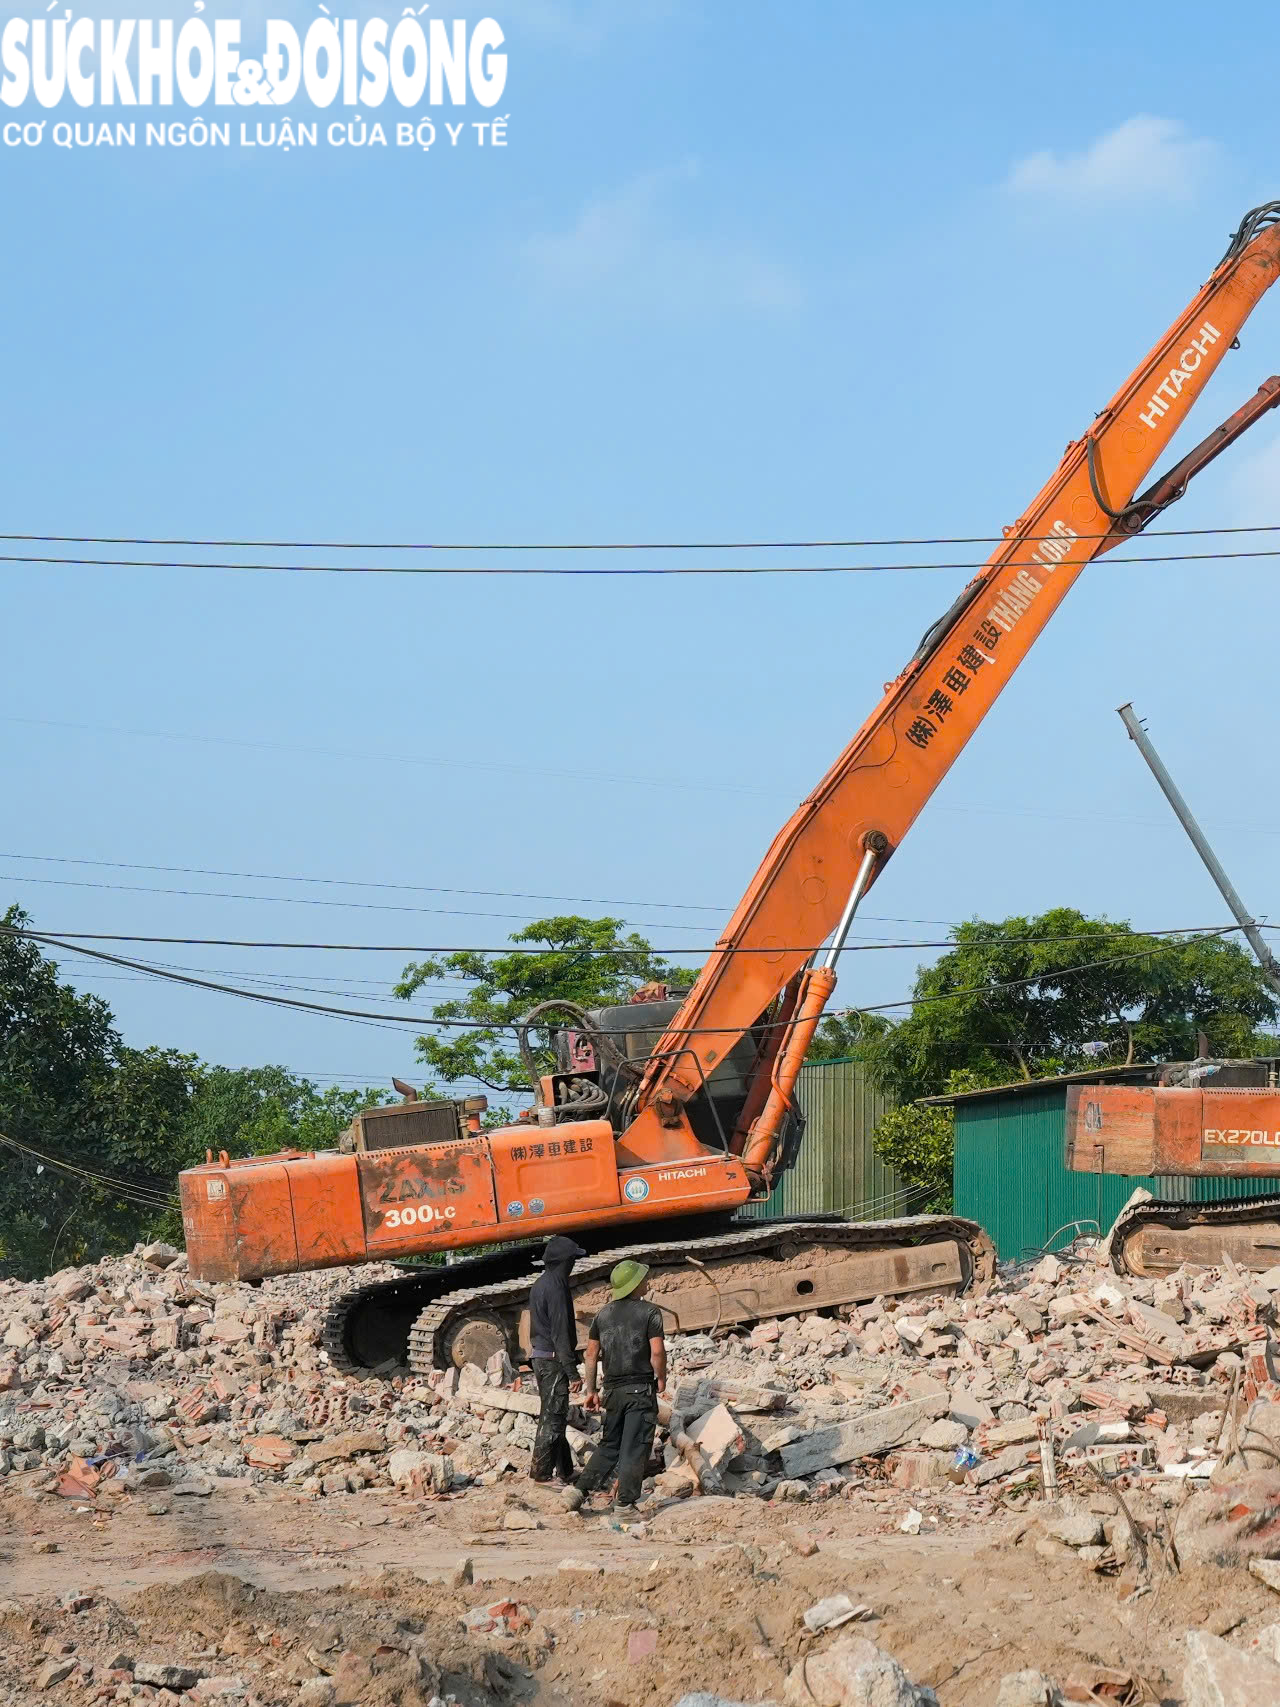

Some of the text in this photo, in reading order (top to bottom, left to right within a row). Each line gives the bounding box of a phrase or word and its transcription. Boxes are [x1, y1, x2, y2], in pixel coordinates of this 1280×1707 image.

[1138, 321, 1222, 430] HITACHI
[986, 519, 1079, 633] THĂNG LONG
[657, 1167, 708, 1182] HITACHI
